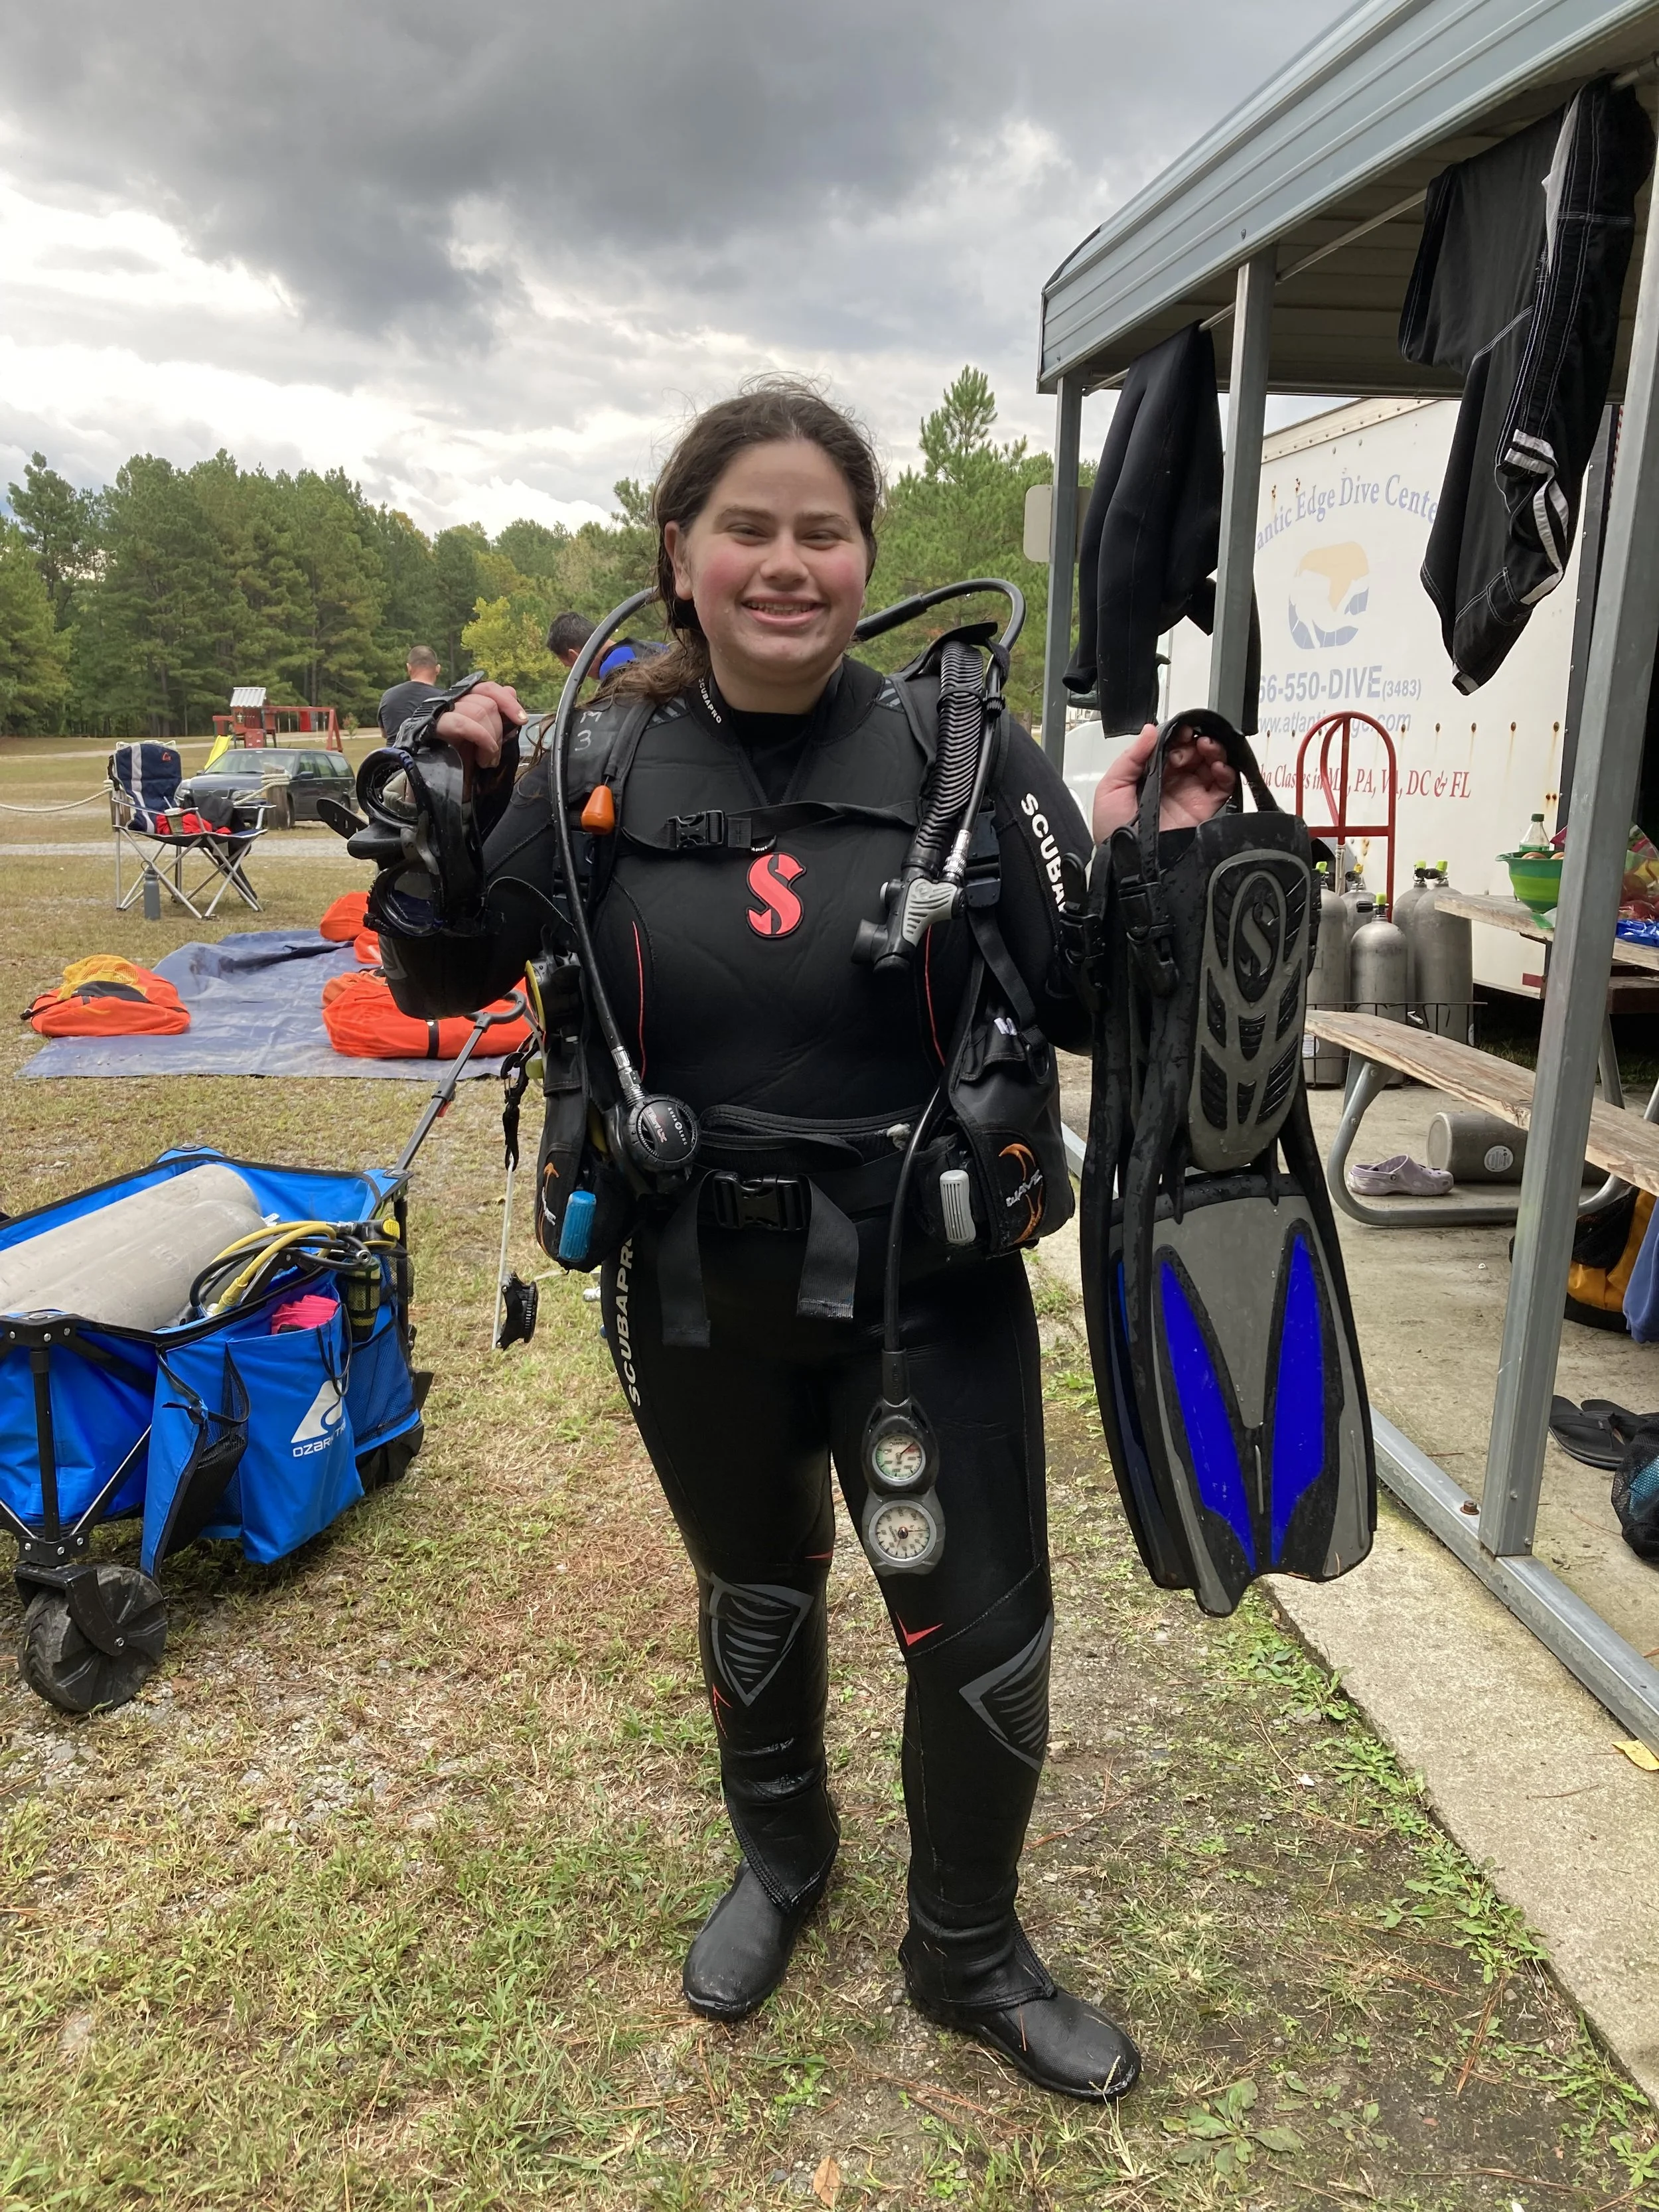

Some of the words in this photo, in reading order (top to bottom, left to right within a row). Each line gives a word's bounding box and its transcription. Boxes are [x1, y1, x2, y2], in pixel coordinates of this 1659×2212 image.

[1255, 506, 1292, 553] antic
[1295, 484, 1335, 522] Edge
[1339, 475, 1380, 506] Dive
[575, 729, 591, 751] 3
[1354, 769, 1376, 798] PA,
[1406, 770, 1431, 796] DC
[1434, 770, 1447, 797] &
[1449, 771, 1471, 798] FL
[1021, 792, 1066, 913] SCUBA
